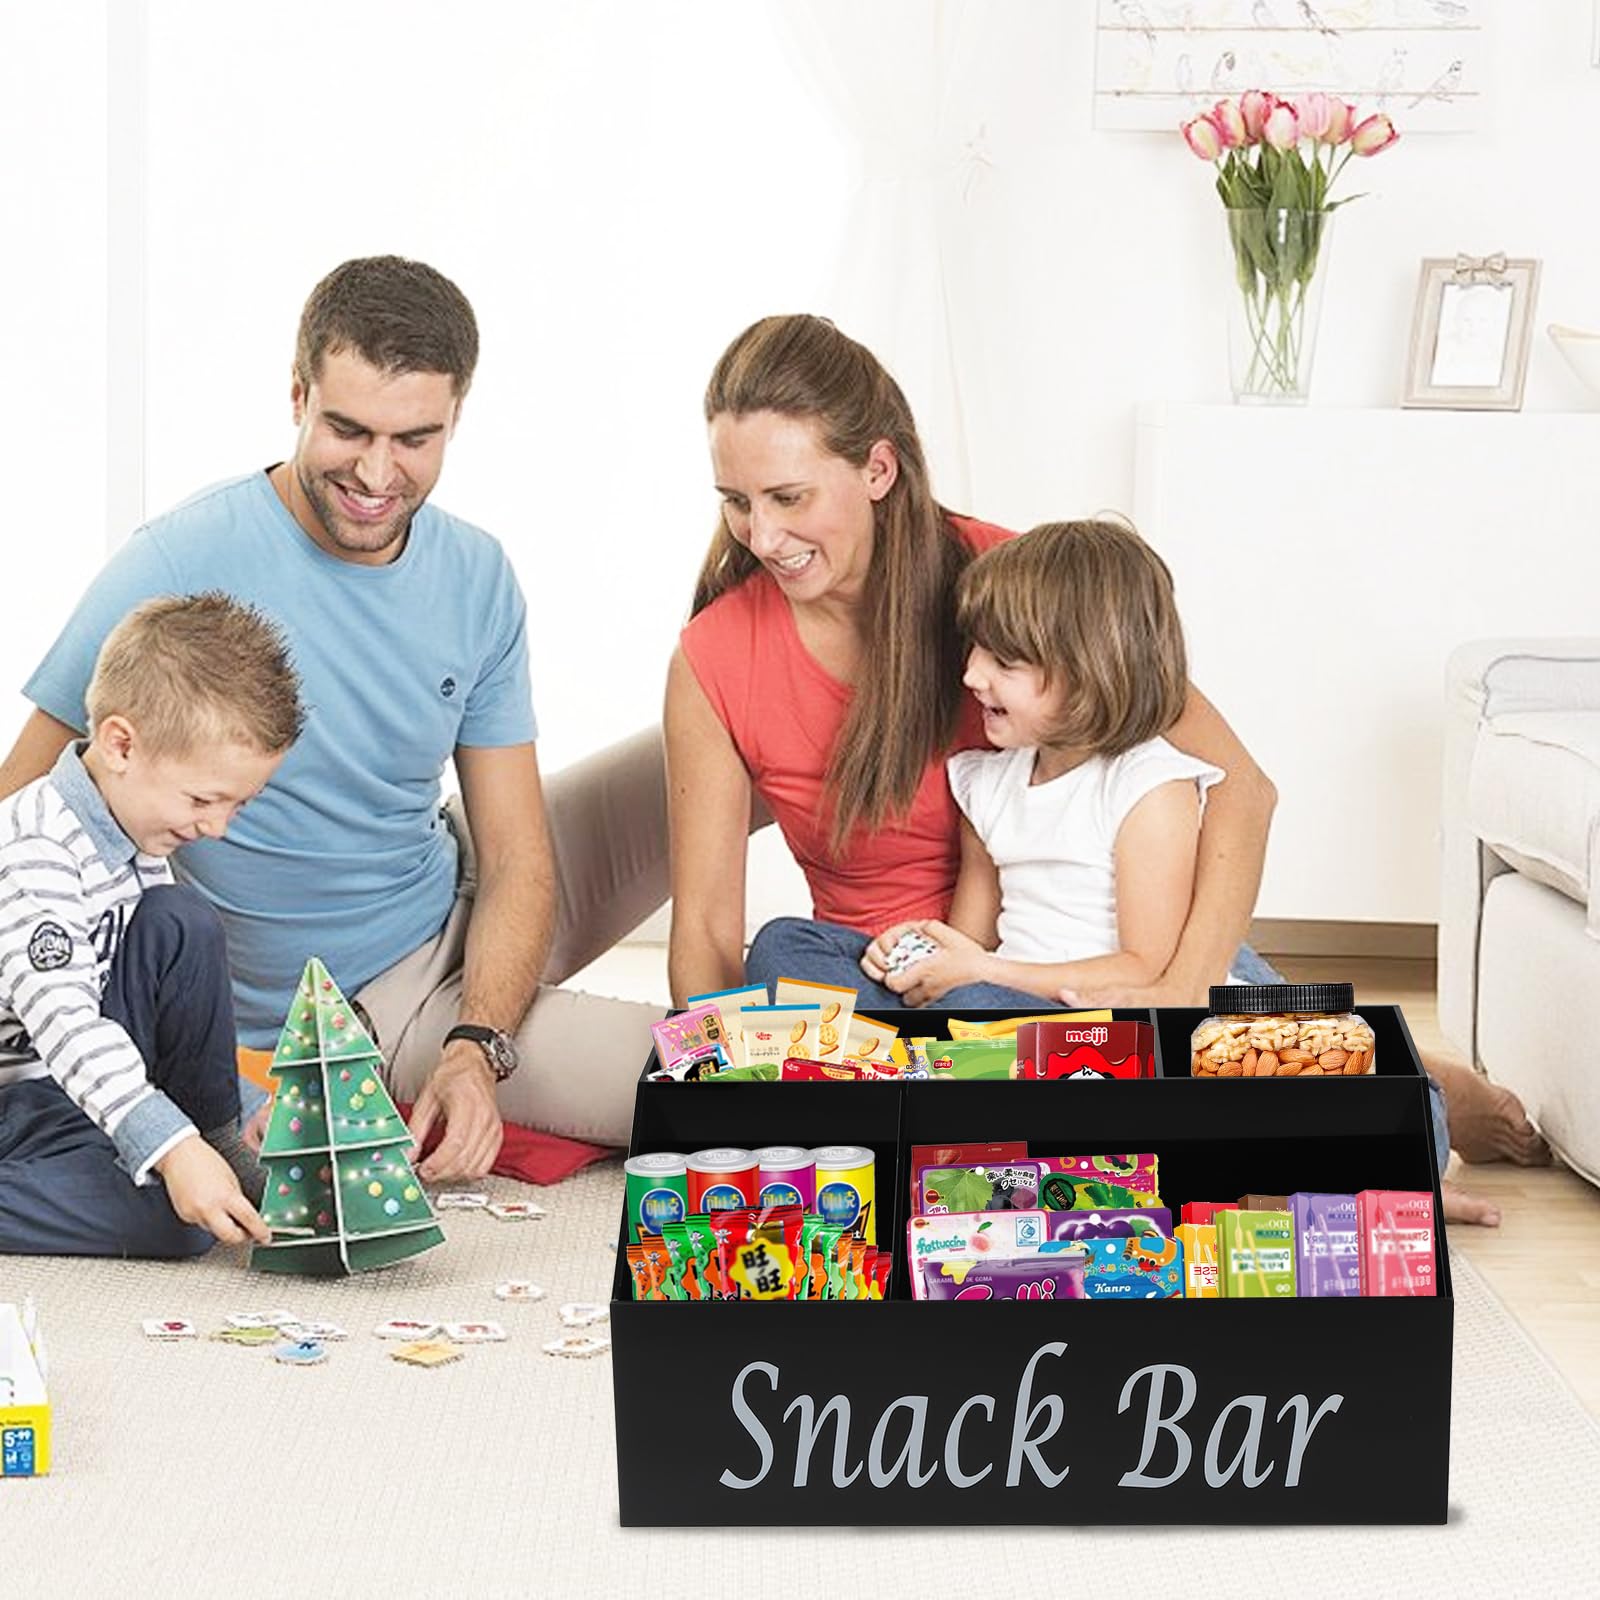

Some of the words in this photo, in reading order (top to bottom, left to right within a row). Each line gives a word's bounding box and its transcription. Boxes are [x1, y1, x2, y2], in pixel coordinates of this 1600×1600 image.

[1066, 1027, 1108, 1046] meiji
[916, 1235, 967, 1255] fettuccine
[1094, 1283, 1131, 1294] Kanro
[719, 1342, 1069, 1489] Snack
[1118, 1364, 1344, 1488] Bar
